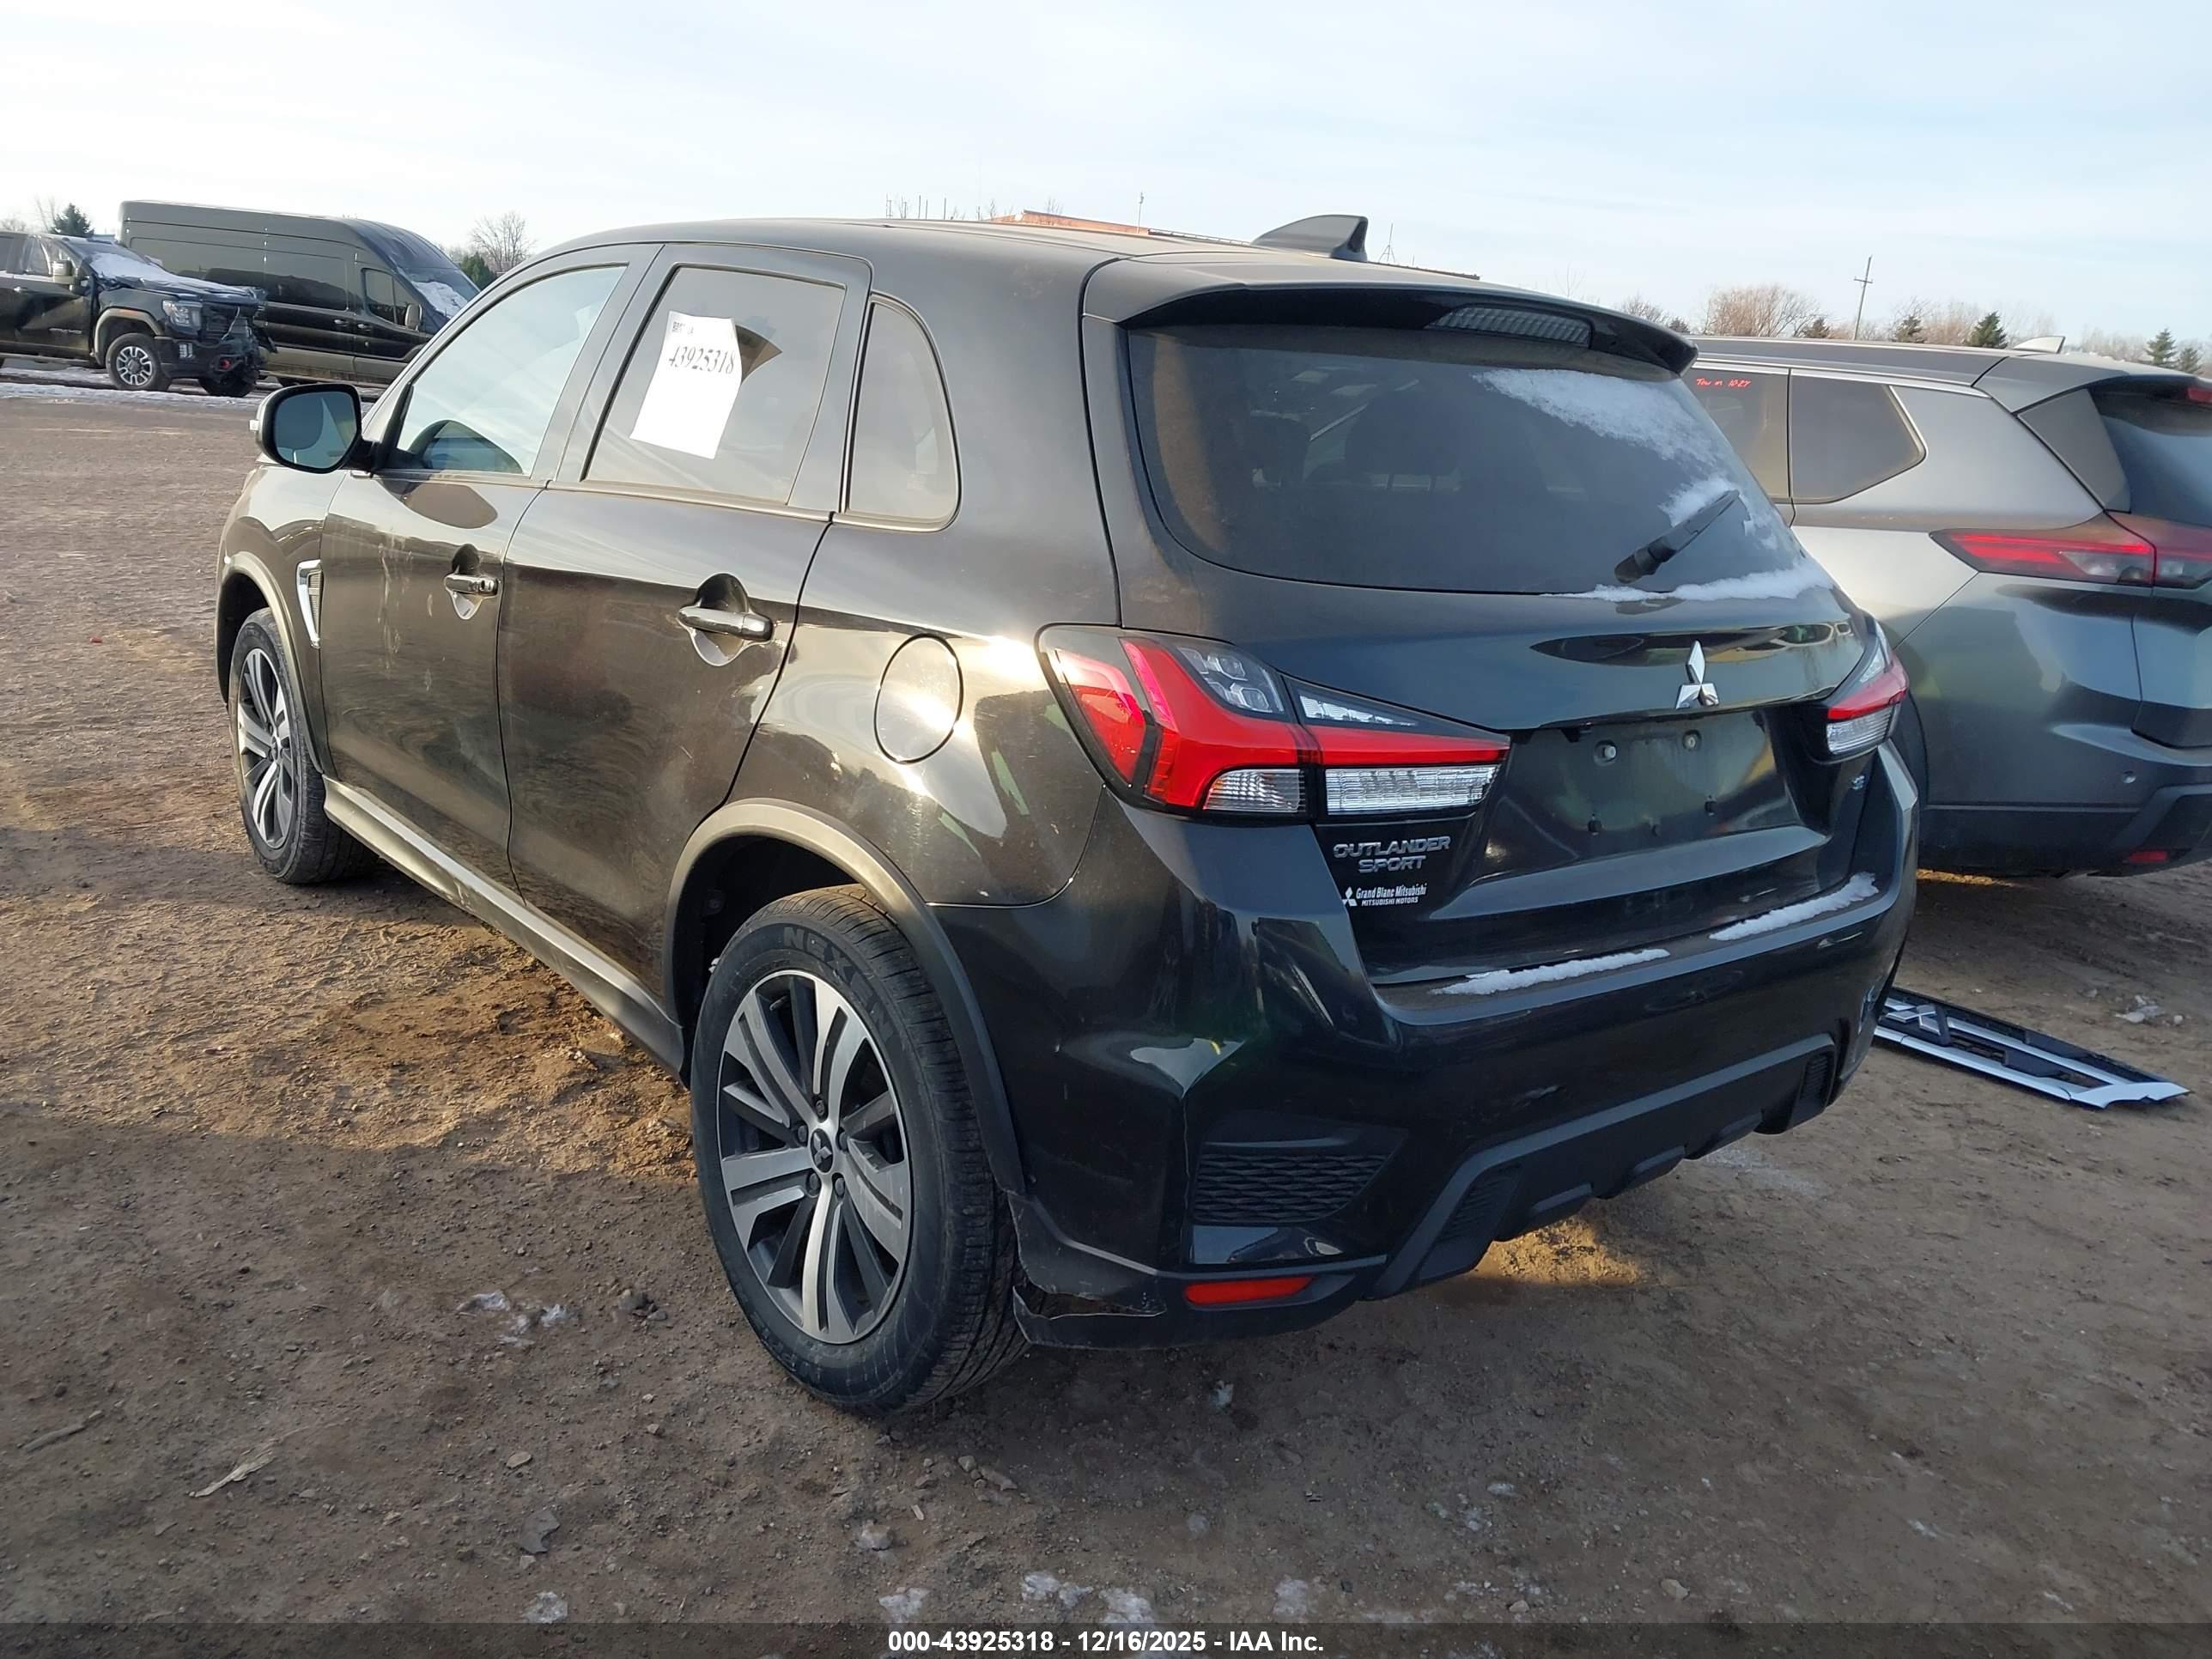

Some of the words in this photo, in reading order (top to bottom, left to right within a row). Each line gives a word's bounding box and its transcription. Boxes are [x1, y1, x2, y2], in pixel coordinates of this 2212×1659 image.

[668, 345, 736, 374] 43925318
[1333, 836, 1451, 858] OUTLANDER
[1358, 855, 1426, 873] SPORT
[1356, 887, 1376, 899] Grand
[1376, 886, 1395, 898] Blanc
[1395, 883, 1427, 897] Mitsubishi
[1361, 897, 1395, 907] MITSUBISHI
[1395, 896, 1419, 905] MOTORS
